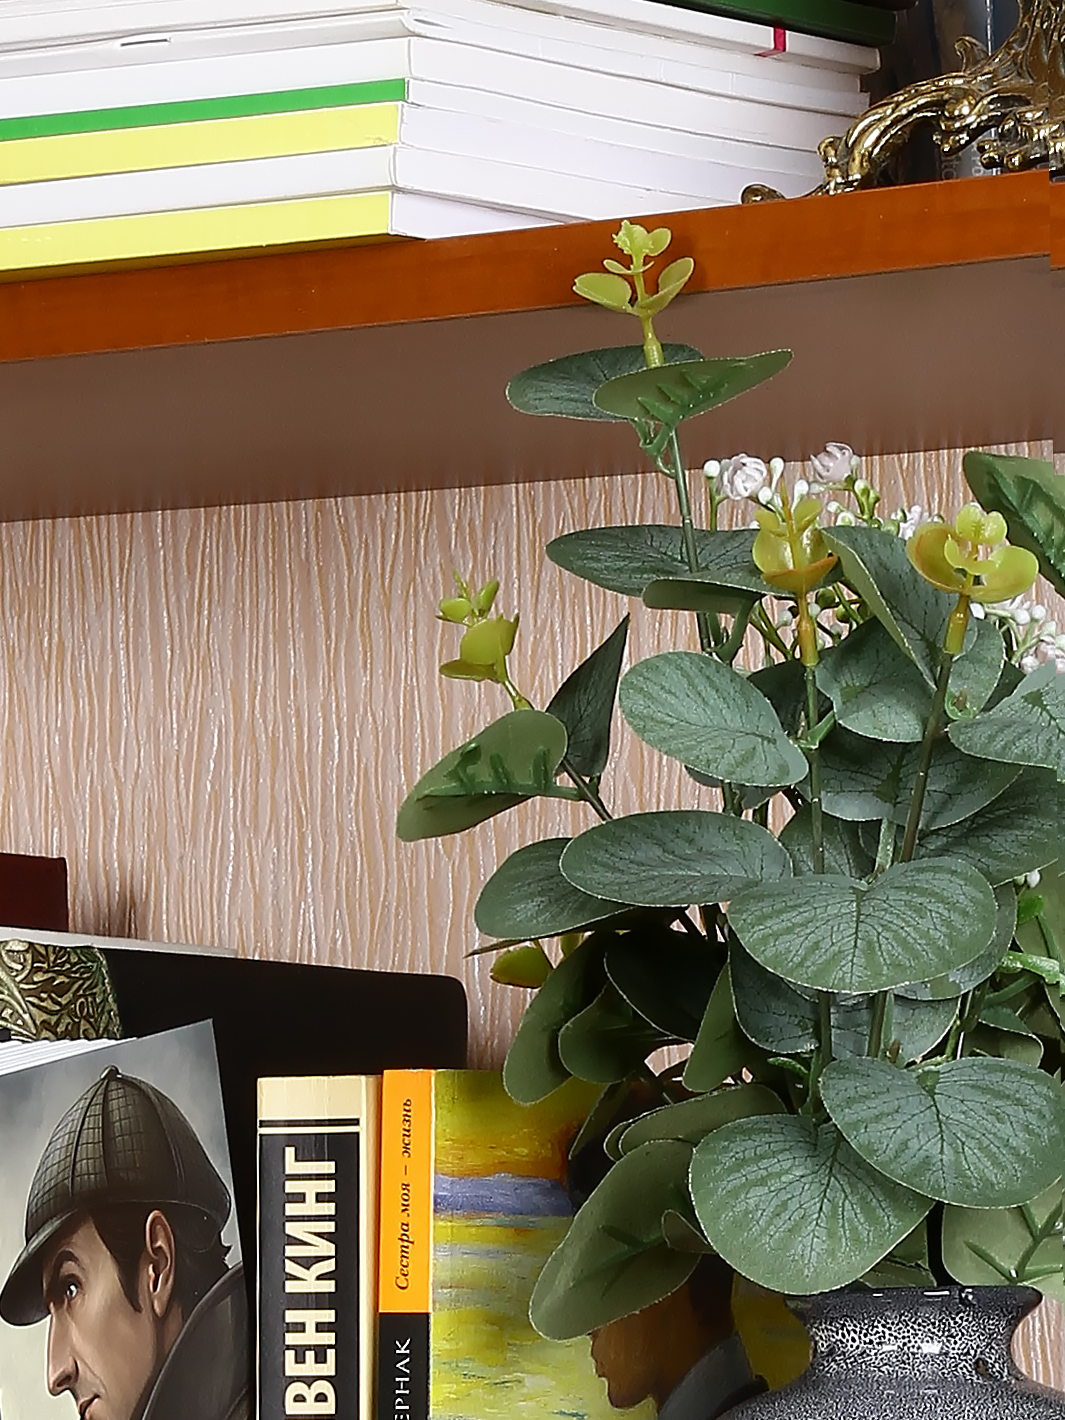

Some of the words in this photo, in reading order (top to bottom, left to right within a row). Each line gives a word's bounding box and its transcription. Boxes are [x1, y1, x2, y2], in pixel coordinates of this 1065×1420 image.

[402, 1098, 413, 1158] жизнь
[284, 1146, 337, 1294] КИНГ
[401, 1183, 411, 1218] моя
[395, 1222, 415, 1291] Сестра
